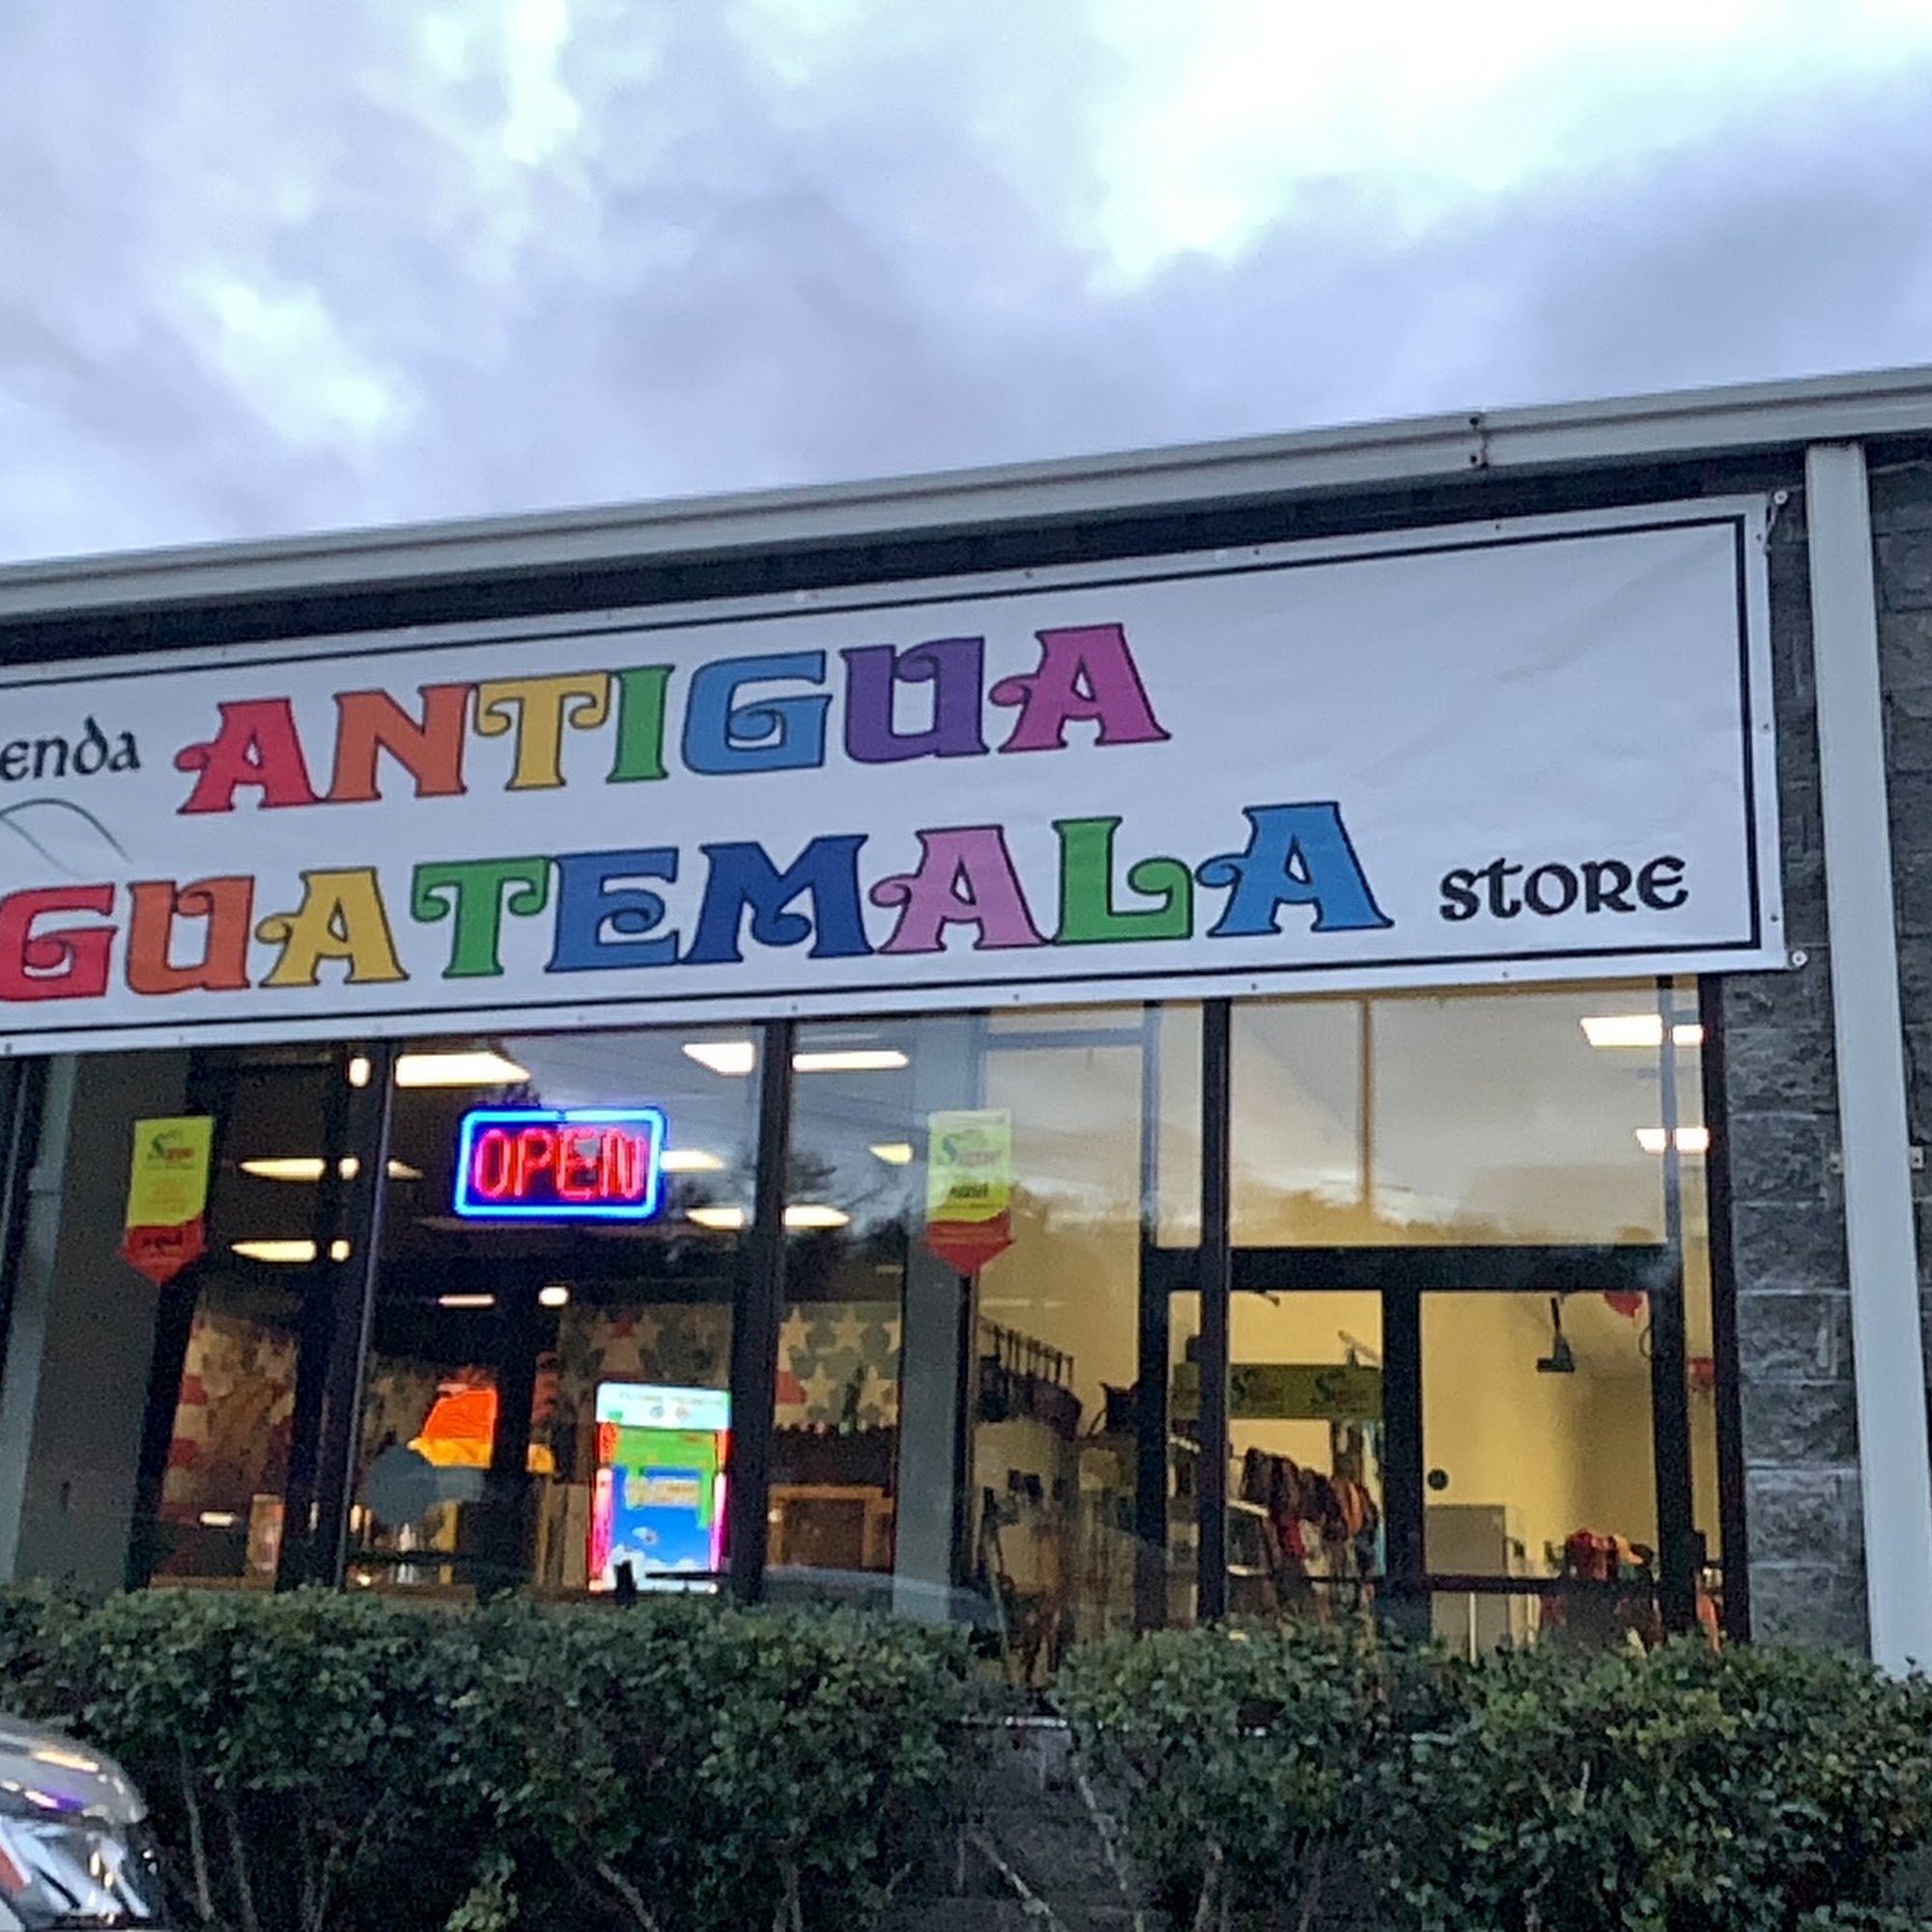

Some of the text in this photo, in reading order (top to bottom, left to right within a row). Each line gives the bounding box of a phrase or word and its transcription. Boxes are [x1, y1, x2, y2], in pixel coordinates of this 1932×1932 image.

[0, 622, 1172, 814] enda ANTIGUA
[0, 801, 1395, 1002] GUATEMALA
[471, 1127, 648, 1200] OPEN
